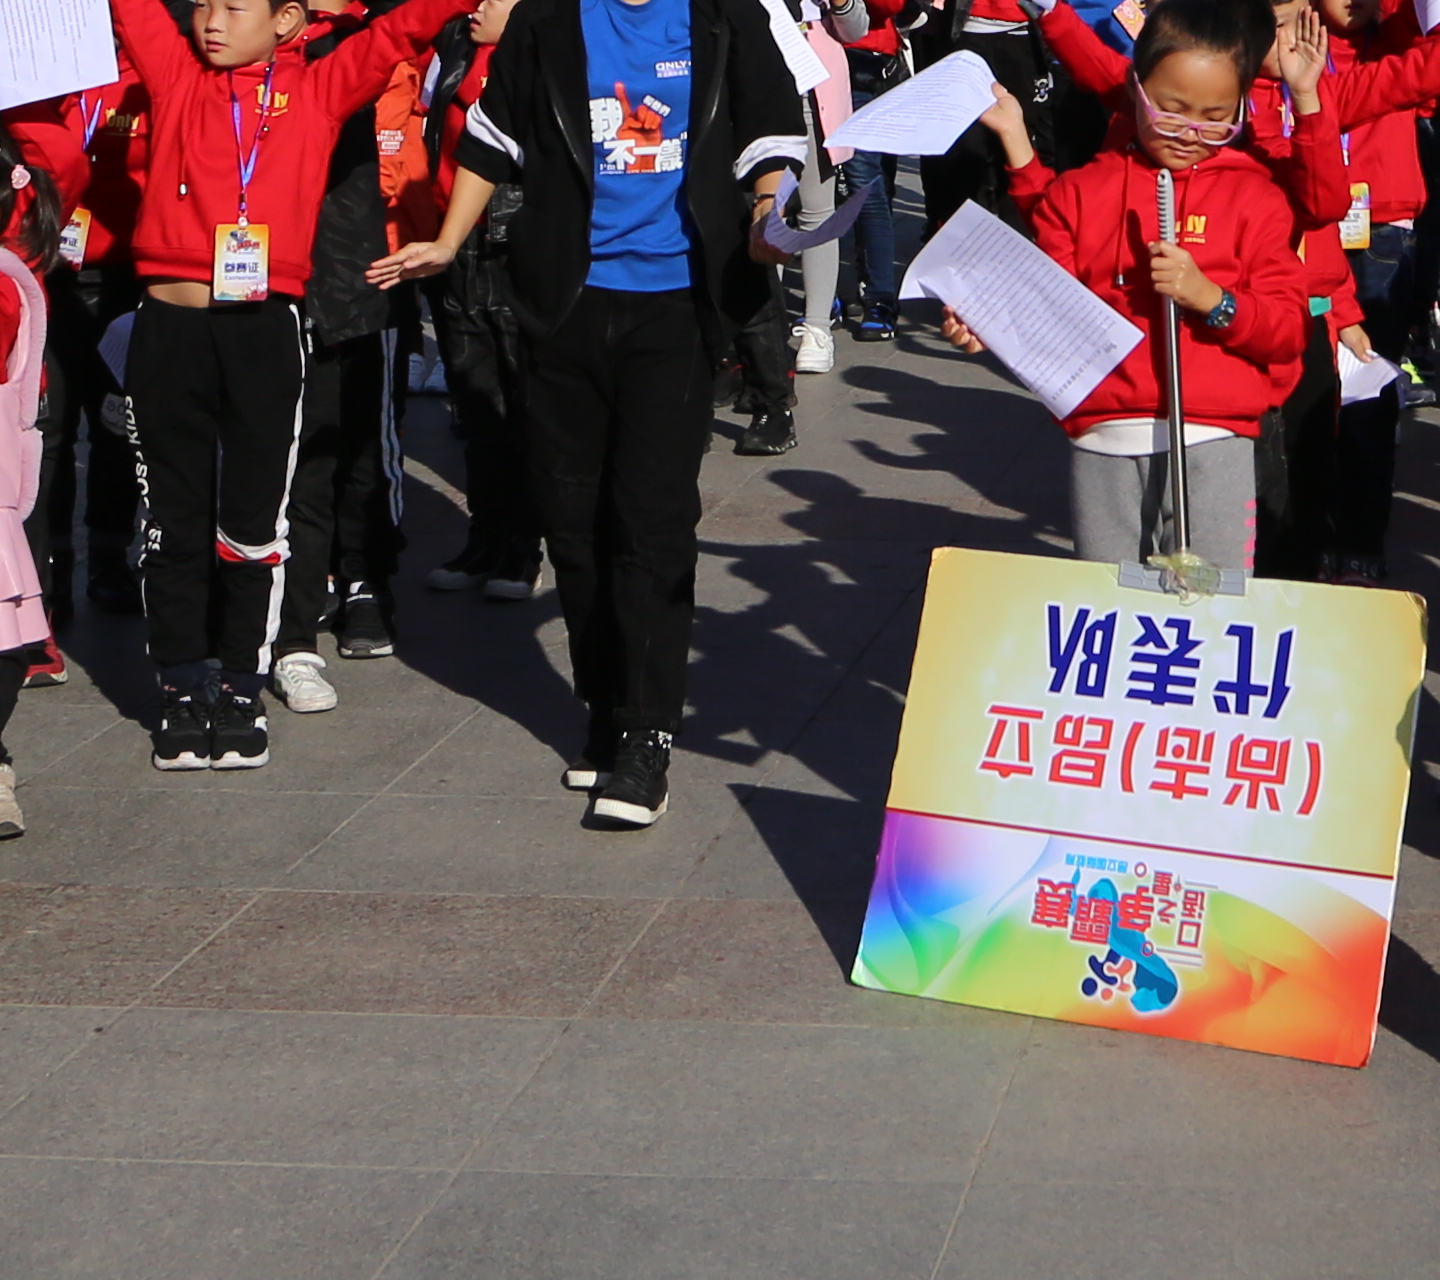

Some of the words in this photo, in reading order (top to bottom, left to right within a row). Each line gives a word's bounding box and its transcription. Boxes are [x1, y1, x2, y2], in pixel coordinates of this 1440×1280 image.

[589, 97, 623, 143] 我
[1046, 604, 1296, 719] 代表队
[978, 704, 1322, 816] (尚志)昂立
[1030, 877, 1159, 948] 争霸赛
